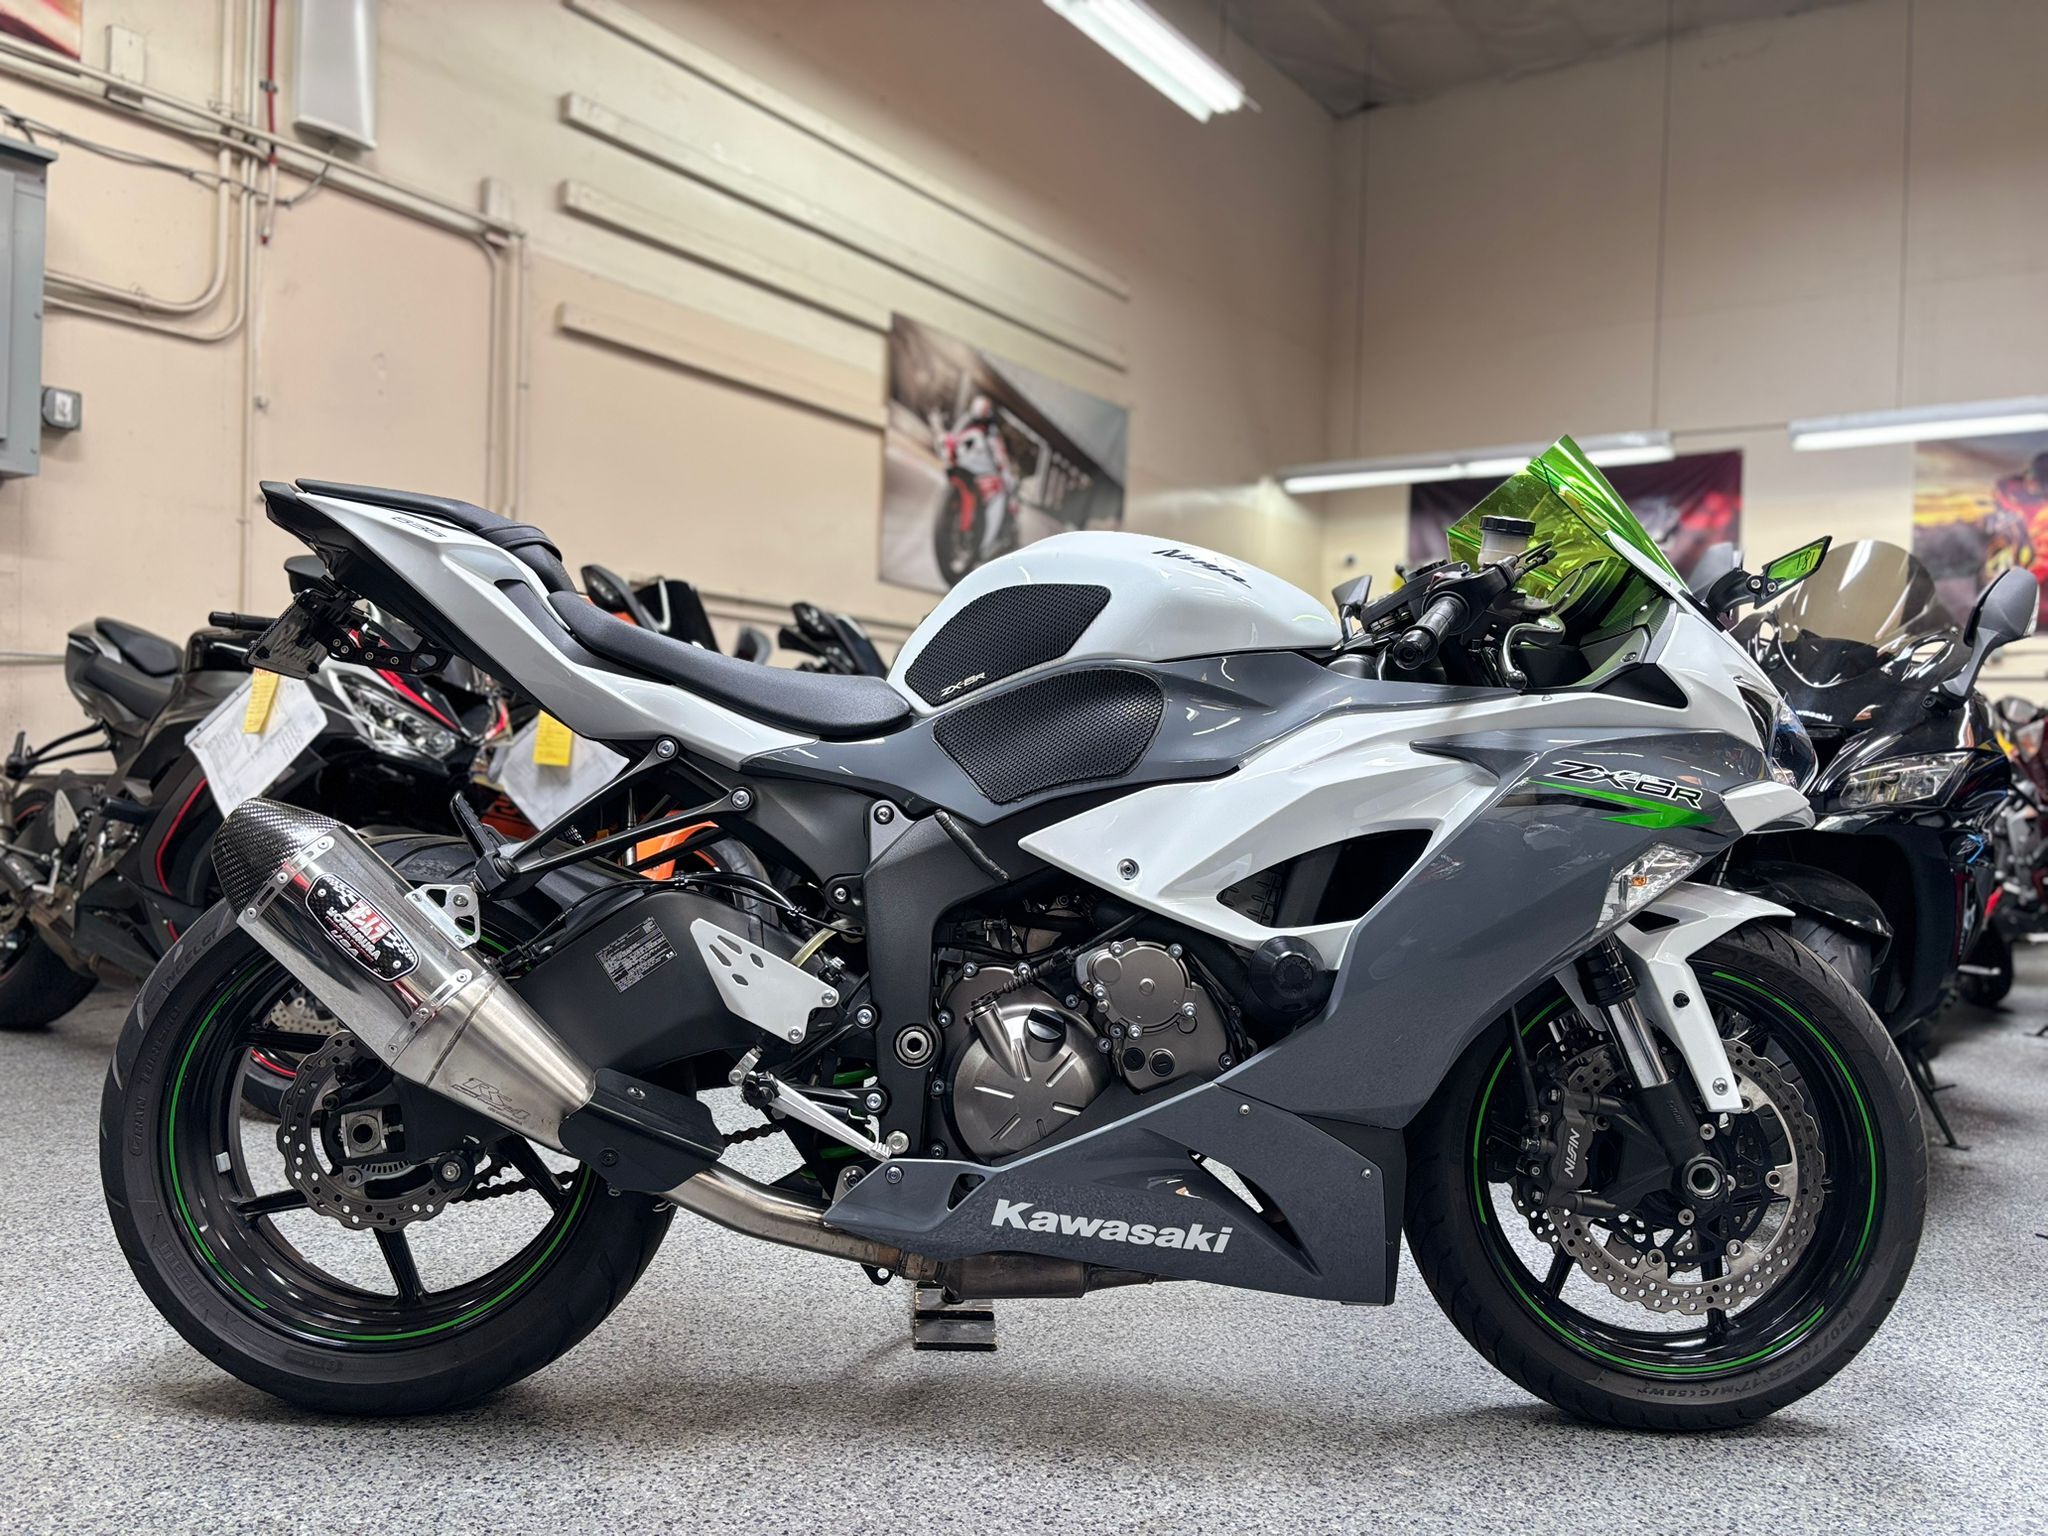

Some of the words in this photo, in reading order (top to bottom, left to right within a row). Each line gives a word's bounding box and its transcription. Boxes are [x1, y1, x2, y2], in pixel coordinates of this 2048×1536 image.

[1152, 549, 1252, 589] Ninja
[1795, 709, 1833, 722] wasaki
[1544, 759, 1703, 810] ZX-6R
[326, 906, 381, 960] YOSHIMURA
[991, 1199, 1233, 1254] Kawasaki
